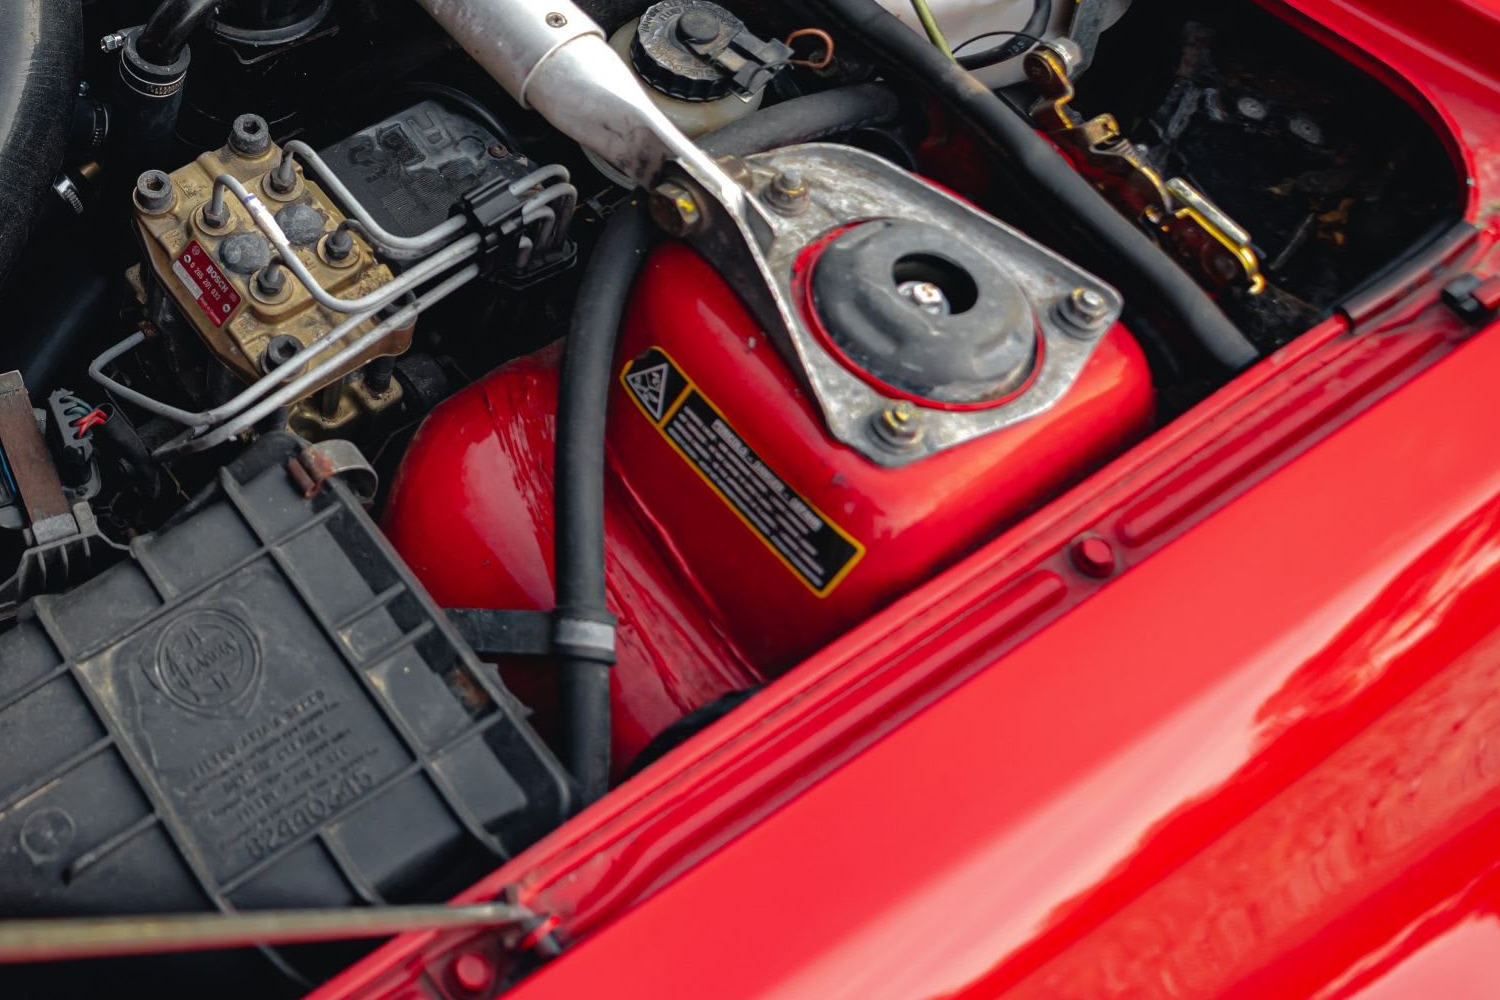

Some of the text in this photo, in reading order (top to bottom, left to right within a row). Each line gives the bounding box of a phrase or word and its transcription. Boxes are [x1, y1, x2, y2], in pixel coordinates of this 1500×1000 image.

[193, 267, 204, 279] 265
[202, 278, 212, 289] 201
[205, 265, 229, 292] BOSCH
[185, 641, 237, 677] LANCIA
